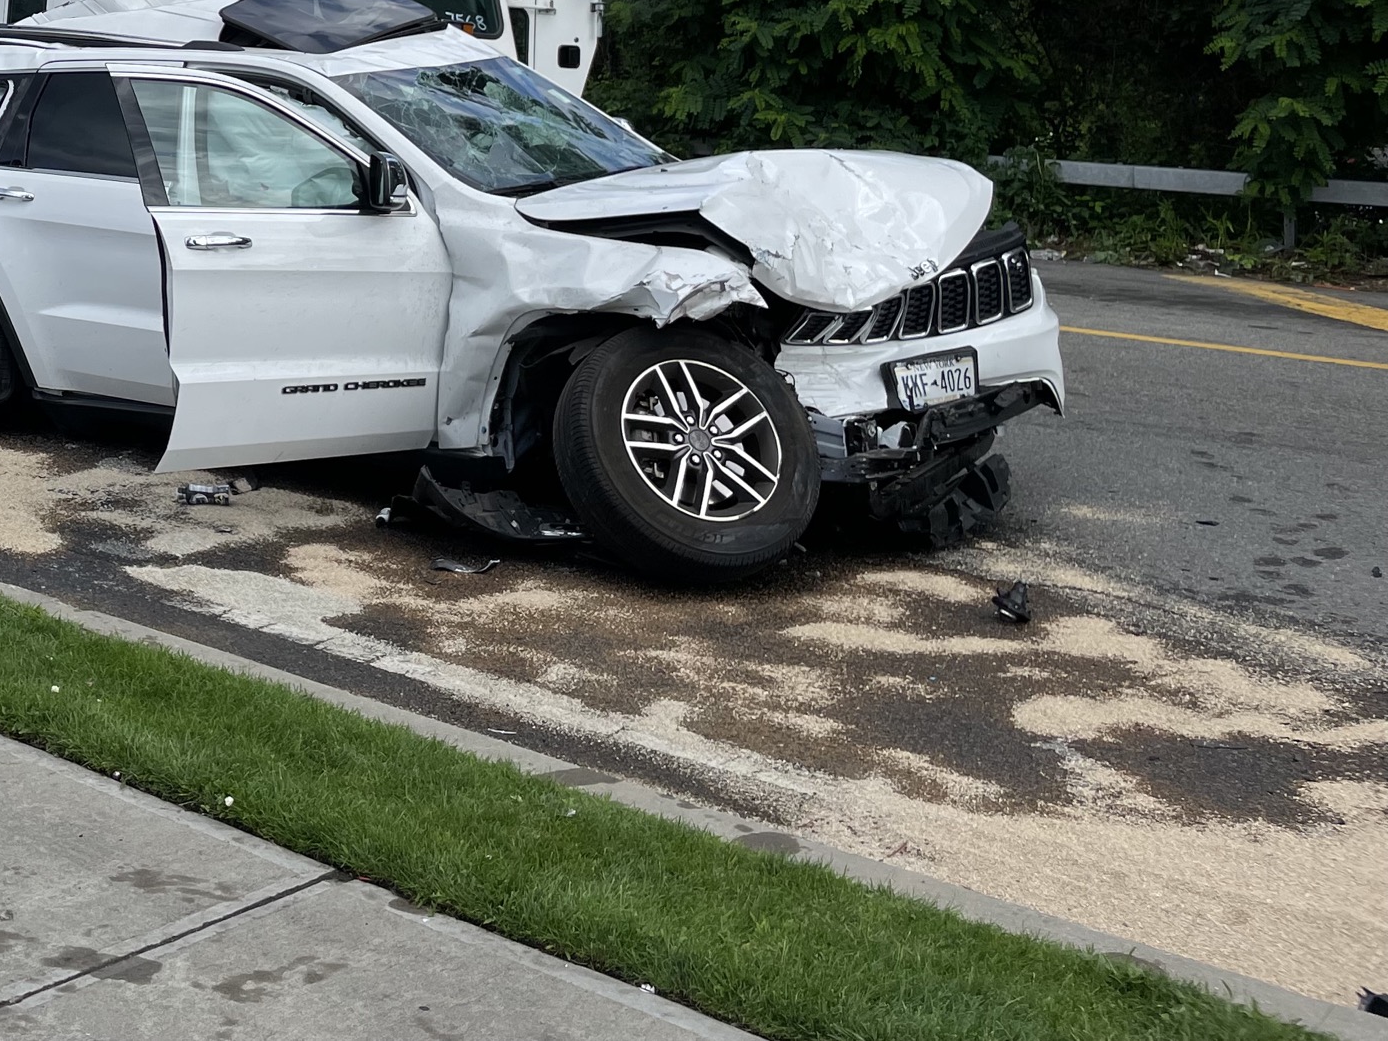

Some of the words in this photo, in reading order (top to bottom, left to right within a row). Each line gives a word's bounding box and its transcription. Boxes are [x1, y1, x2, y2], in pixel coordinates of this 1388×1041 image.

[908, 258, 938, 280] Jeep
[913, 362, 933, 372] NEW
[935, 359, 955, 369] YORK
[282, 383, 338, 394] GRAND
[343, 377, 426, 390] CHEROKEE
